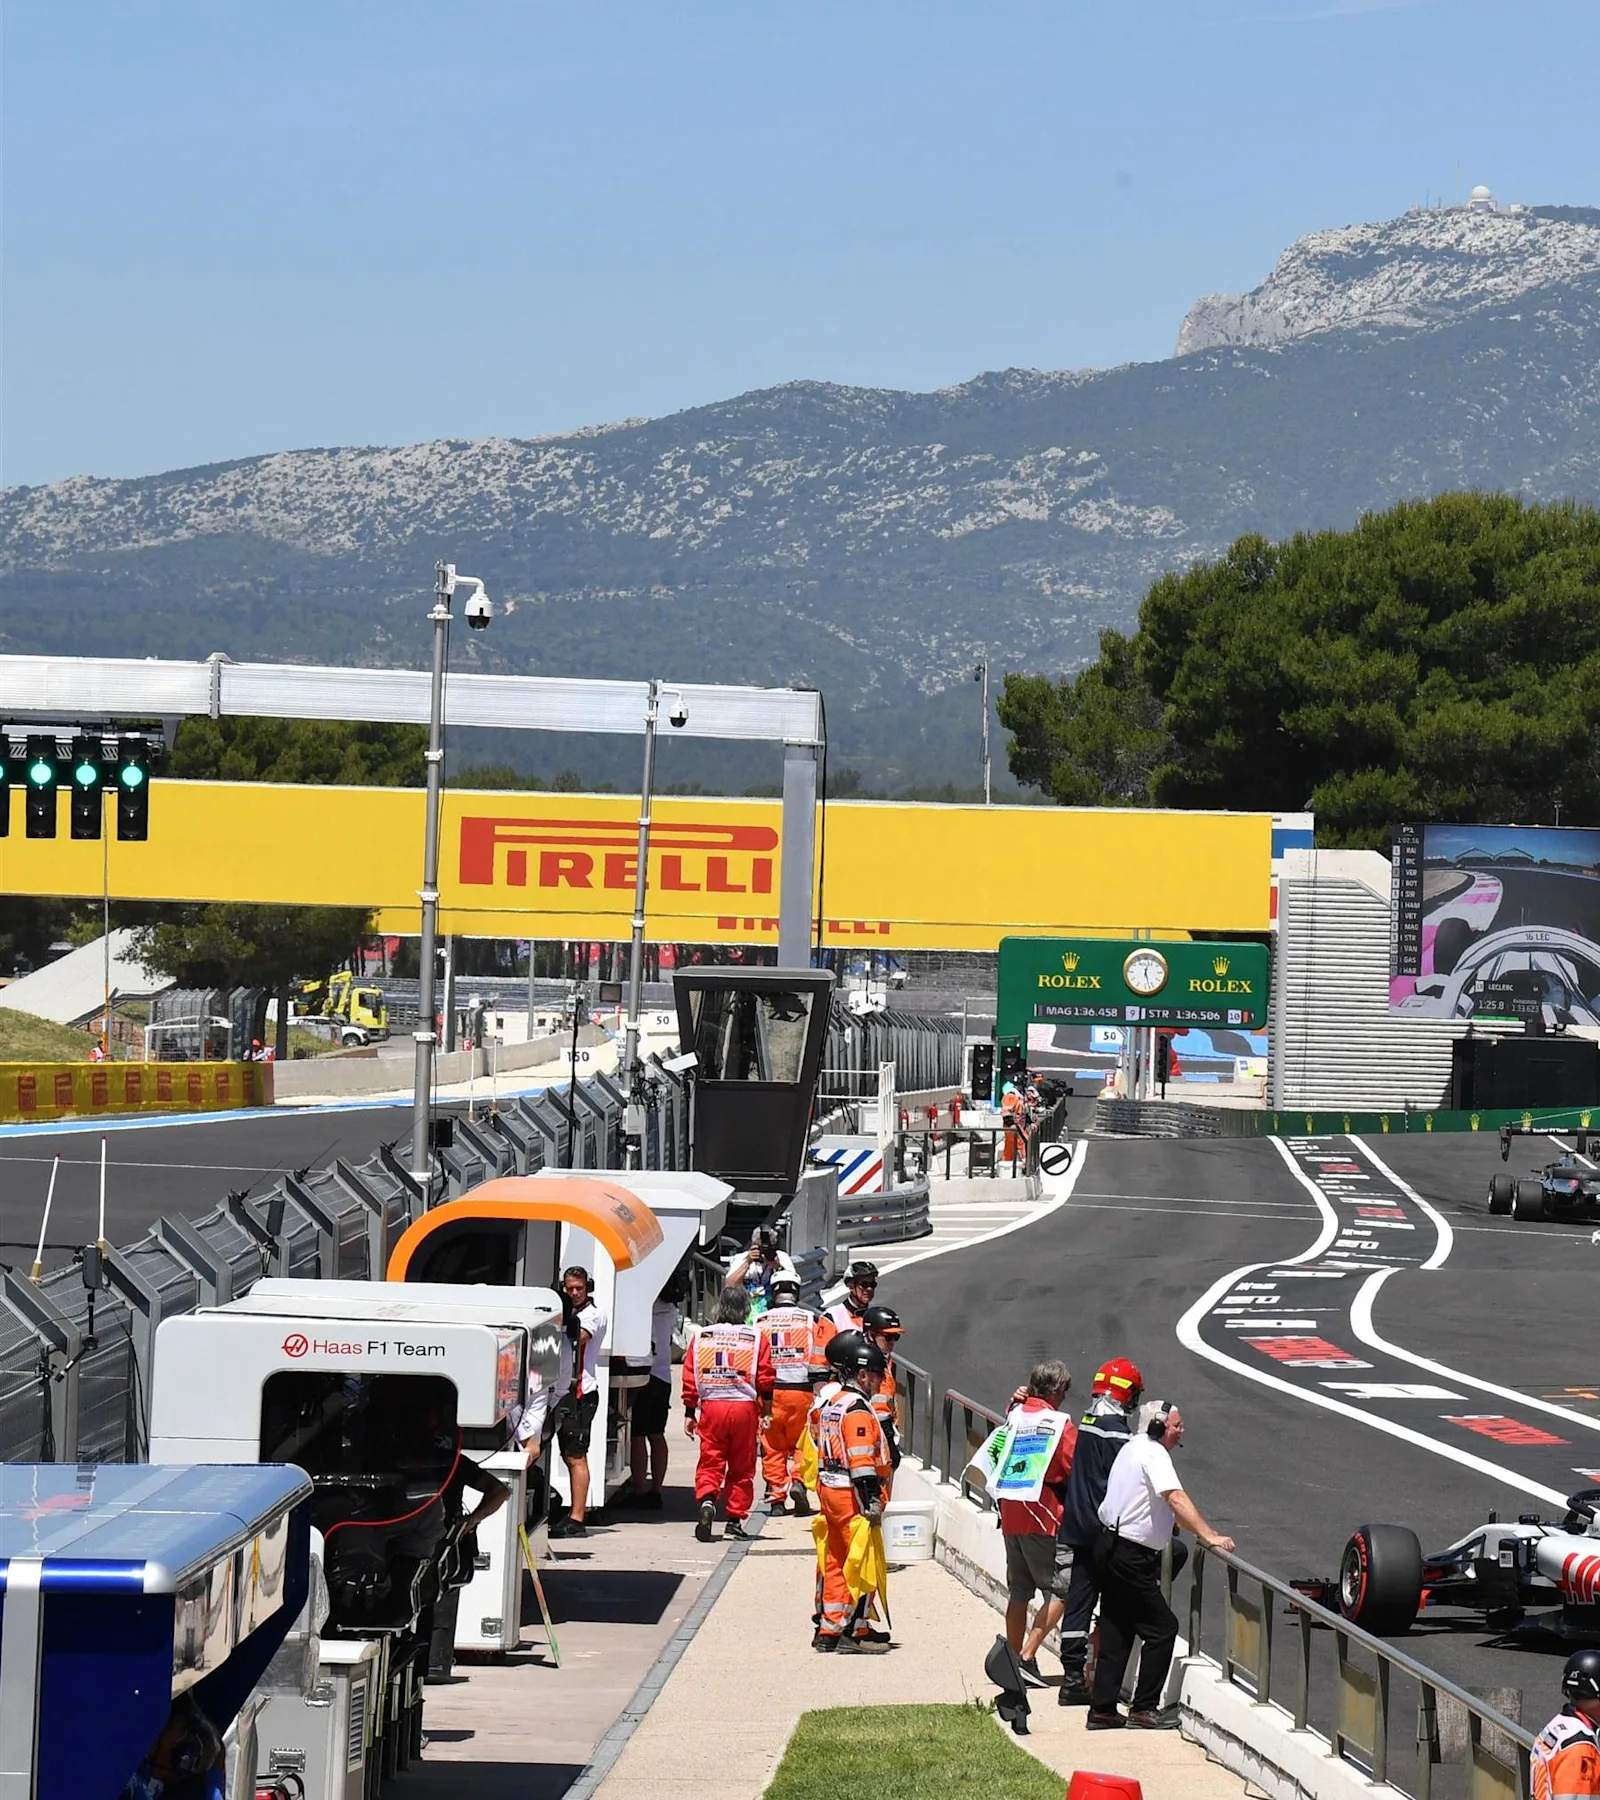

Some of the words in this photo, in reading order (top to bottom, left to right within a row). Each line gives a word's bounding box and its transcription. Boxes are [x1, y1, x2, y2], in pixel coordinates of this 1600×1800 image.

[460, 816, 778, 893] PIRELLI
[1525, 933, 1533, 941] 16
[1038, 975, 1102, 989] ROLEX
[1188, 979, 1253, 993] ROLEX
[1488, 983, 1513, 991] LECLERC
[656, 1016, 670, 1025] 50
[1046, 1007, 1071, 1016] MAG
[1074, 1007, 1118, 1017] 1:36.458
[1149, 1010, 1169, 1019] STR
[1229, 1012, 1240, 1021] 10
[1103, 1032, 1116, 1041] 50
[313, 1339, 363, 1355] Haas
[367, 1341, 387, 1356] F1
[392, 1342, 446, 1357] Team
